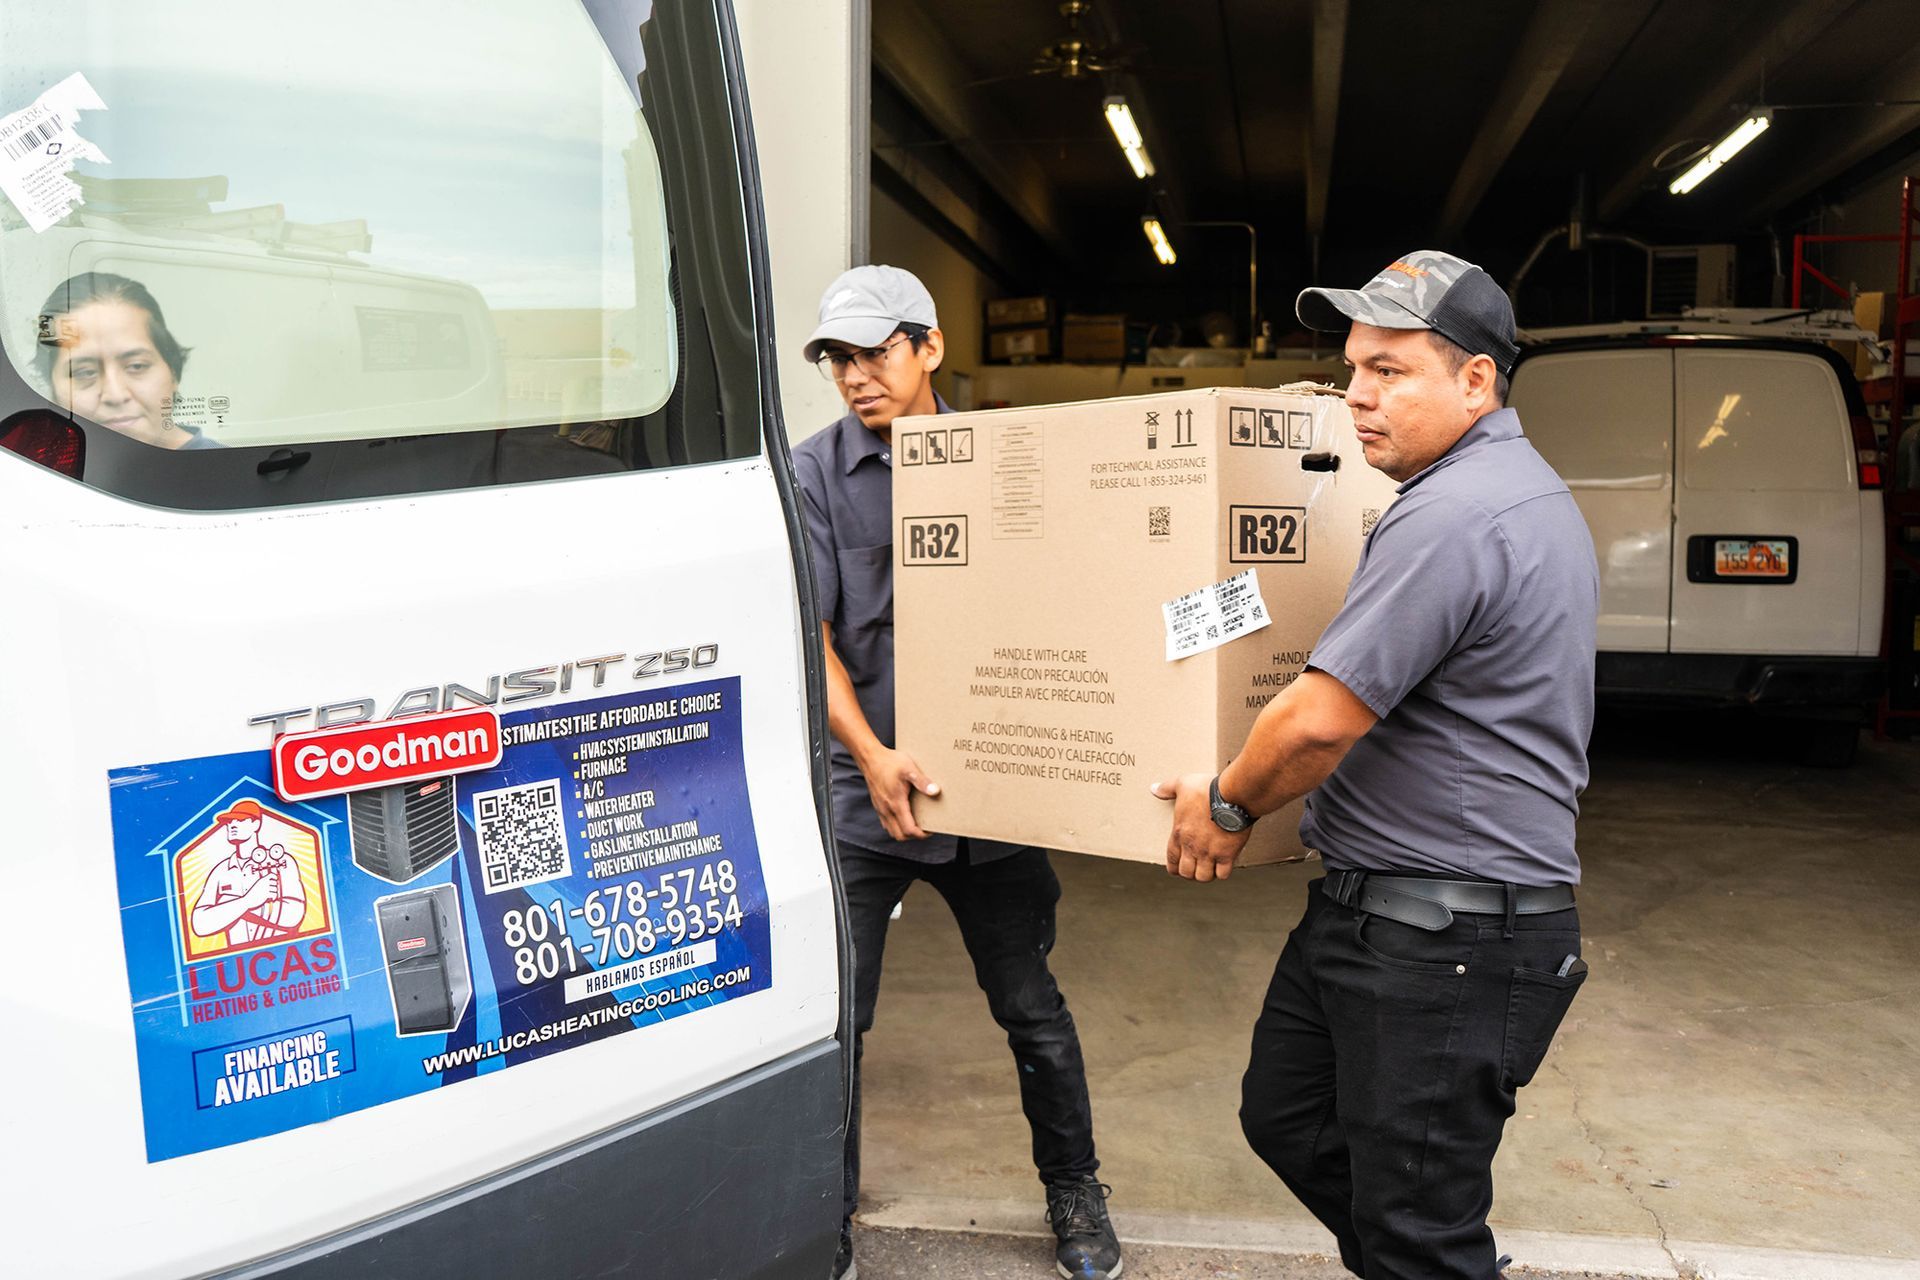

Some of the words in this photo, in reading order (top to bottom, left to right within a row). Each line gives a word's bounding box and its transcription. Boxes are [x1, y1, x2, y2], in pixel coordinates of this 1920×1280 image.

[1090, 478, 1118, 489] PLEASE
[1120, 477, 1141, 488] CALL
[1143, 473, 1207, 487] 1-855-324-5461
[1091, 462, 1107, 473] FOR
[1109, 460, 1153, 473] TECHNICAL
[1156, 457, 1206, 470] ASSISTANCE
[910, 523, 959, 558] R32
[1239, 514, 1297, 555] R32
[994, 648, 1032, 661] HANDLE
[1034, 649, 1059, 662] WITH
[1061, 650, 1087, 662] CARE
[248, 653, 627, 735] TRANSIT
[633, 643, 719, 680] 250
[970, 685, 1023, 699] MANIPULER
[1025, 687, 1050, 700] AVEC
[1051, 687, 1115, 704] PRÉCAUTION
[975, 666, 1019, 679] MANEJAR
[1020, 668, 1042, 681] CON
[1044, 668, 1108, 684] PRECAUCIÓN
[501, 716, 572, 746] STIMATES!
[573, 712, 598, 734] THE
[600, 700, 677, 729] AFFORDABLE
[680, 692, 722, 716] CHOICE
[971, 722, 986, 734] AIR
[987, 723, 1058, 740] CONDITIONING
[1060, 728, 1068, 741] &
[1070, 730, 1113, 744] HEATING
[294, 725, 489, 782] Goodman
[581, 740, 607, 760] HVAC
[607, 732, 646, 754] SYSTEM
[646, 721, 709, 749] INSTALLATION
[953, 739, 972, 752] AIRE
[975, 741, 1056, 759] ACONDICIONADO
[1057, 748, 1064, 760] Y
[1065, 749, 1136, 767] CALEFACCIÓN
[581, 756, 627, 780] FURNACE
[964, 759, 980, 770] AIR
[981, 759, 1046, 778] CONDITIONNÉ
[1049, 767, 1060, 779] ET
[1062, 768, 1122, 786] CHAUFFAGE
[583, 780, 604, 800] A/C
[585, 796, 618, 819] WATER
[618, 790, 655, 814] HEATER
[587, 819, 614, 840] DUCT
[613, 812, 645, 833] WORK
[590, 839, 611, 859] GAS
[612, 833, 633, 854] LINE
[633, 820, 698, 850] INSTALLATION
[594, 851, 656, 879] PREVENTIVE
[655, 835, 722, 865] MAINTENANCE
[503, 859, 737, 948] 801-678-5748
[514, 894, 743, 985] 801-708-9354
[189, 938, 337, 1000] LUCAS
[586, 966, 645, 994] HABLAMOS
[649, 949, 696, 976] ESPAÑOL
[192, 994, 258, 1024] HEATING
[263, 990, 275, 1008] &
[278, 974, 341, 1005] COOLING
[423, 966, 750, 1075] WWW.LUCASHEATINGCOOLING.COM
[224, 1030, 327, 1076] FINANCING
[214, 1050, 341, 1108] AVAILABLE
